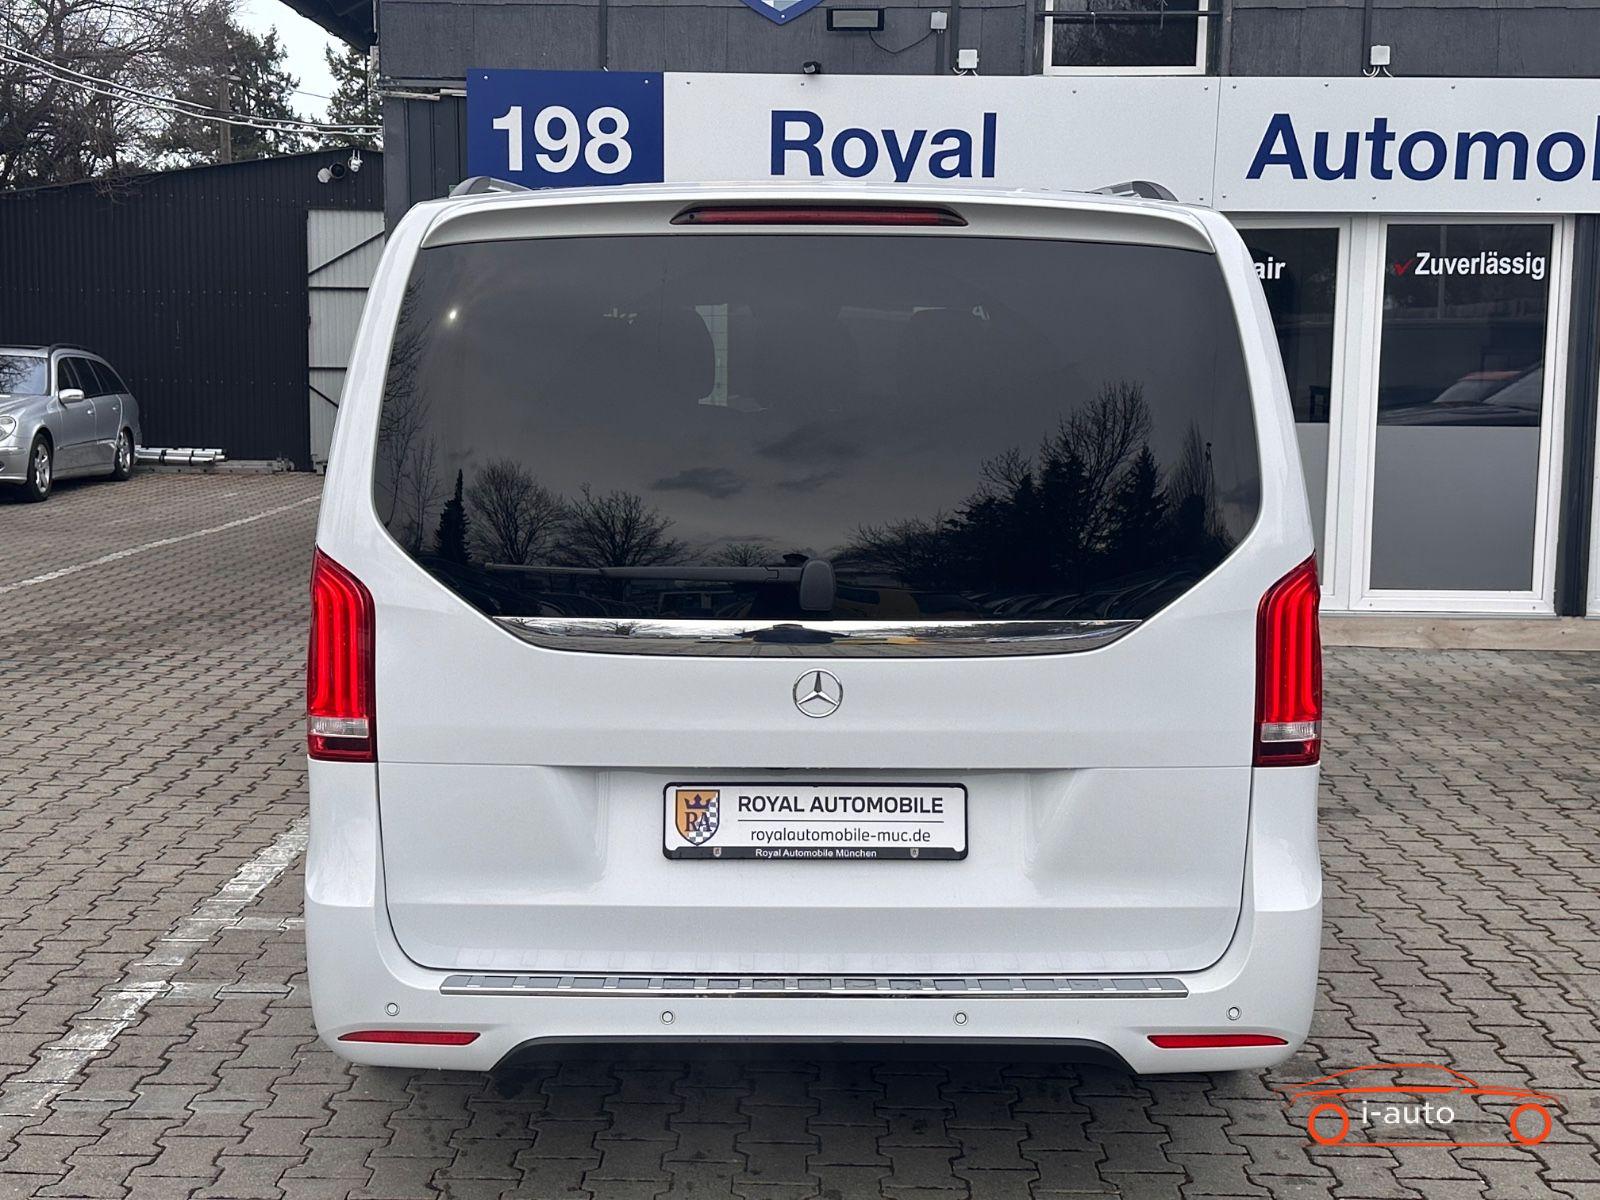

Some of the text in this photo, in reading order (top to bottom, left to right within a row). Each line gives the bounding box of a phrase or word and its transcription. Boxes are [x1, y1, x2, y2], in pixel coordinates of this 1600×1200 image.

[492, 105, 633, 174] 198
[770, 110, 1600, 182] Royal Automo
[1414, 251, 1546, 281] Zuverlässig
[738, 796, 944, 814] ROYAL AUTOMOBILE
[685, 810, 713, 833] RA
[751, 827, 931, 844] royalautomobile-muc.de
[755, 848, 877, 859] Royal Automobile München
